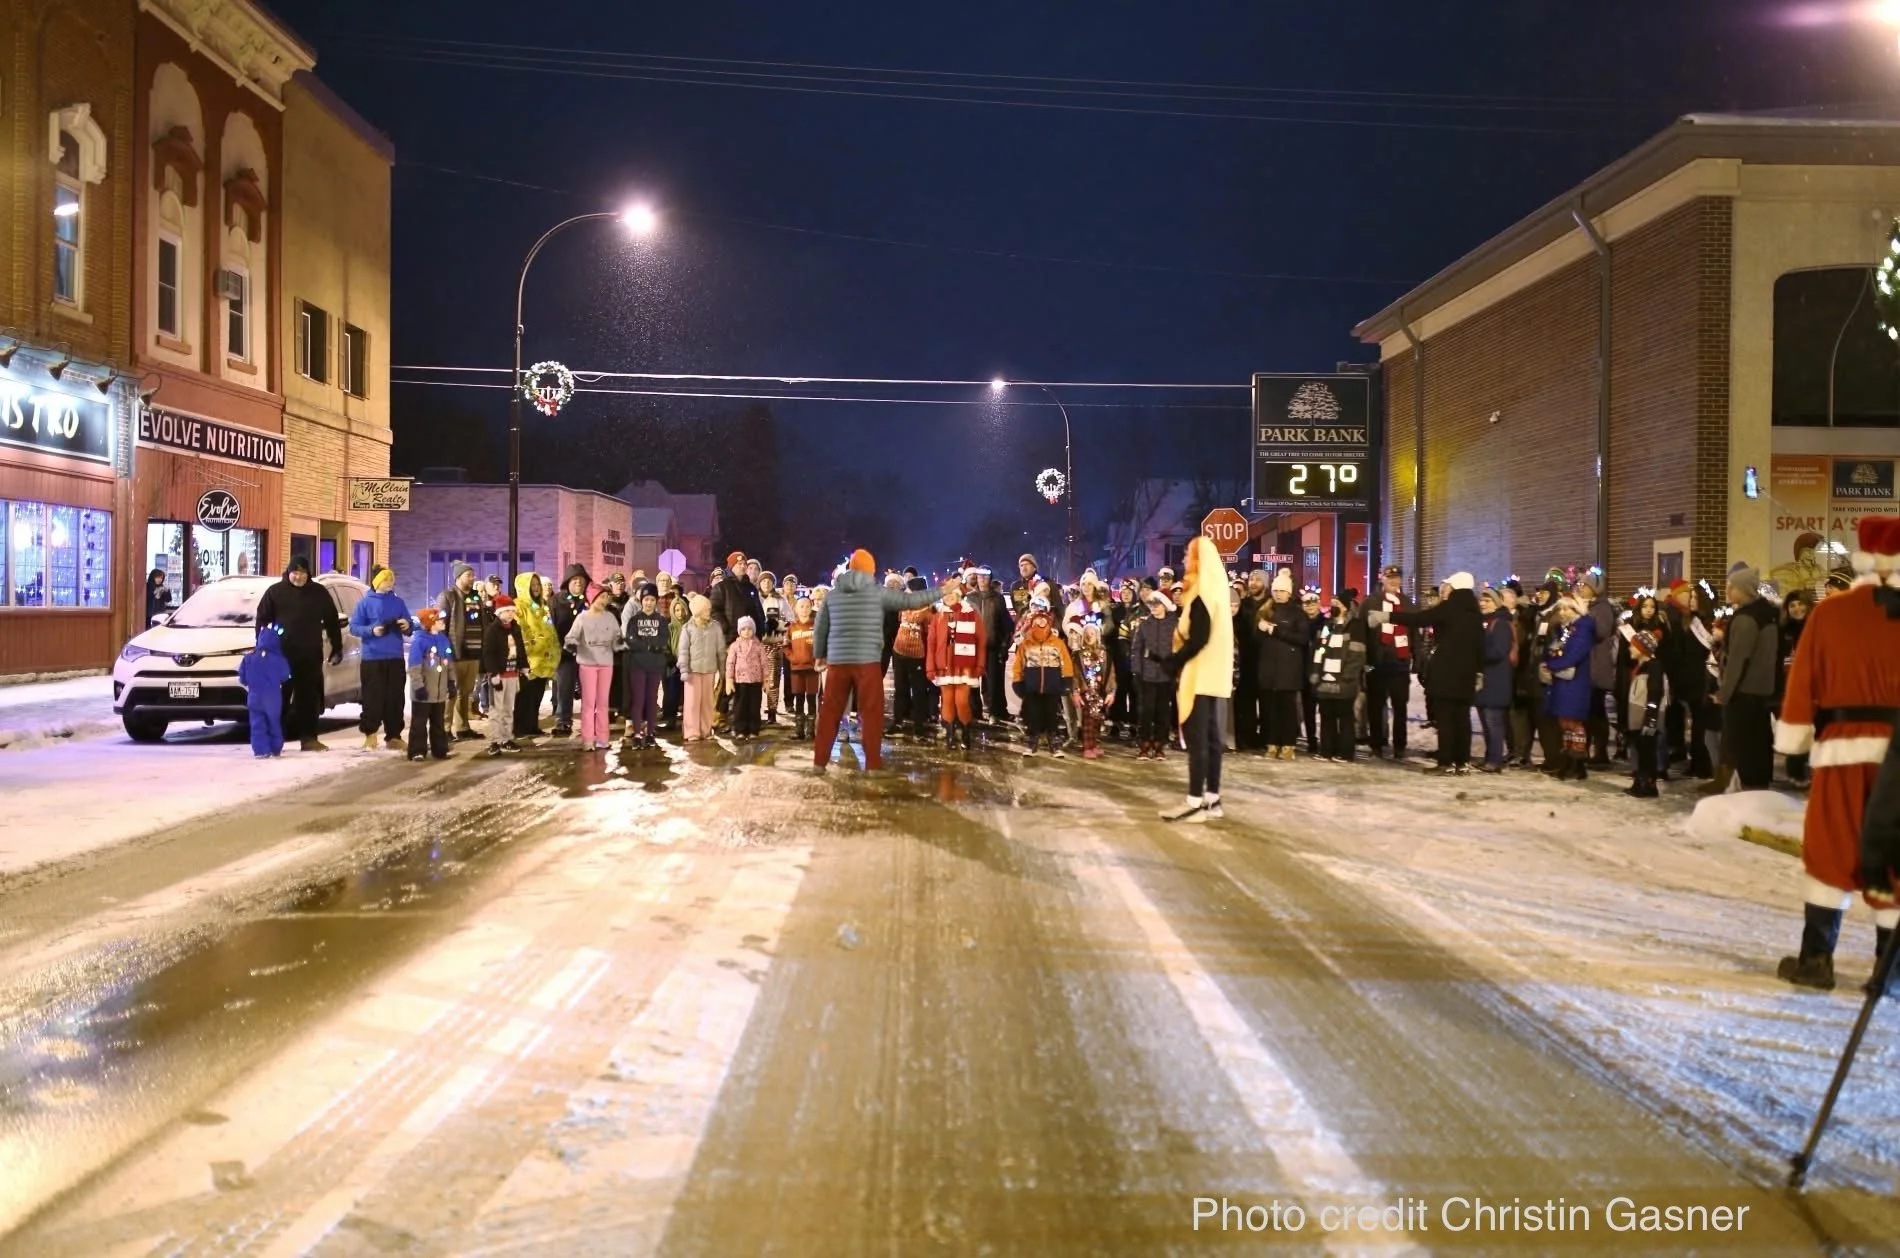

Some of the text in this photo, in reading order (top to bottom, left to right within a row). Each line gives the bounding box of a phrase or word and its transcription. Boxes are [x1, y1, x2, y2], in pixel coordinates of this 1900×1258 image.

[140, 410, 284, 465] EVOLVE NUTRITION
[1260, 428, 1366, 442] PARK BANK
[364, 481, 409, 493] McClain
[1836, 487, 1892, 496] PARK BANK
[372, 493, 407, 506] Realty
[200, 496, 240, 521] Evolve
[1205, 522, 1245, 541] STOP
